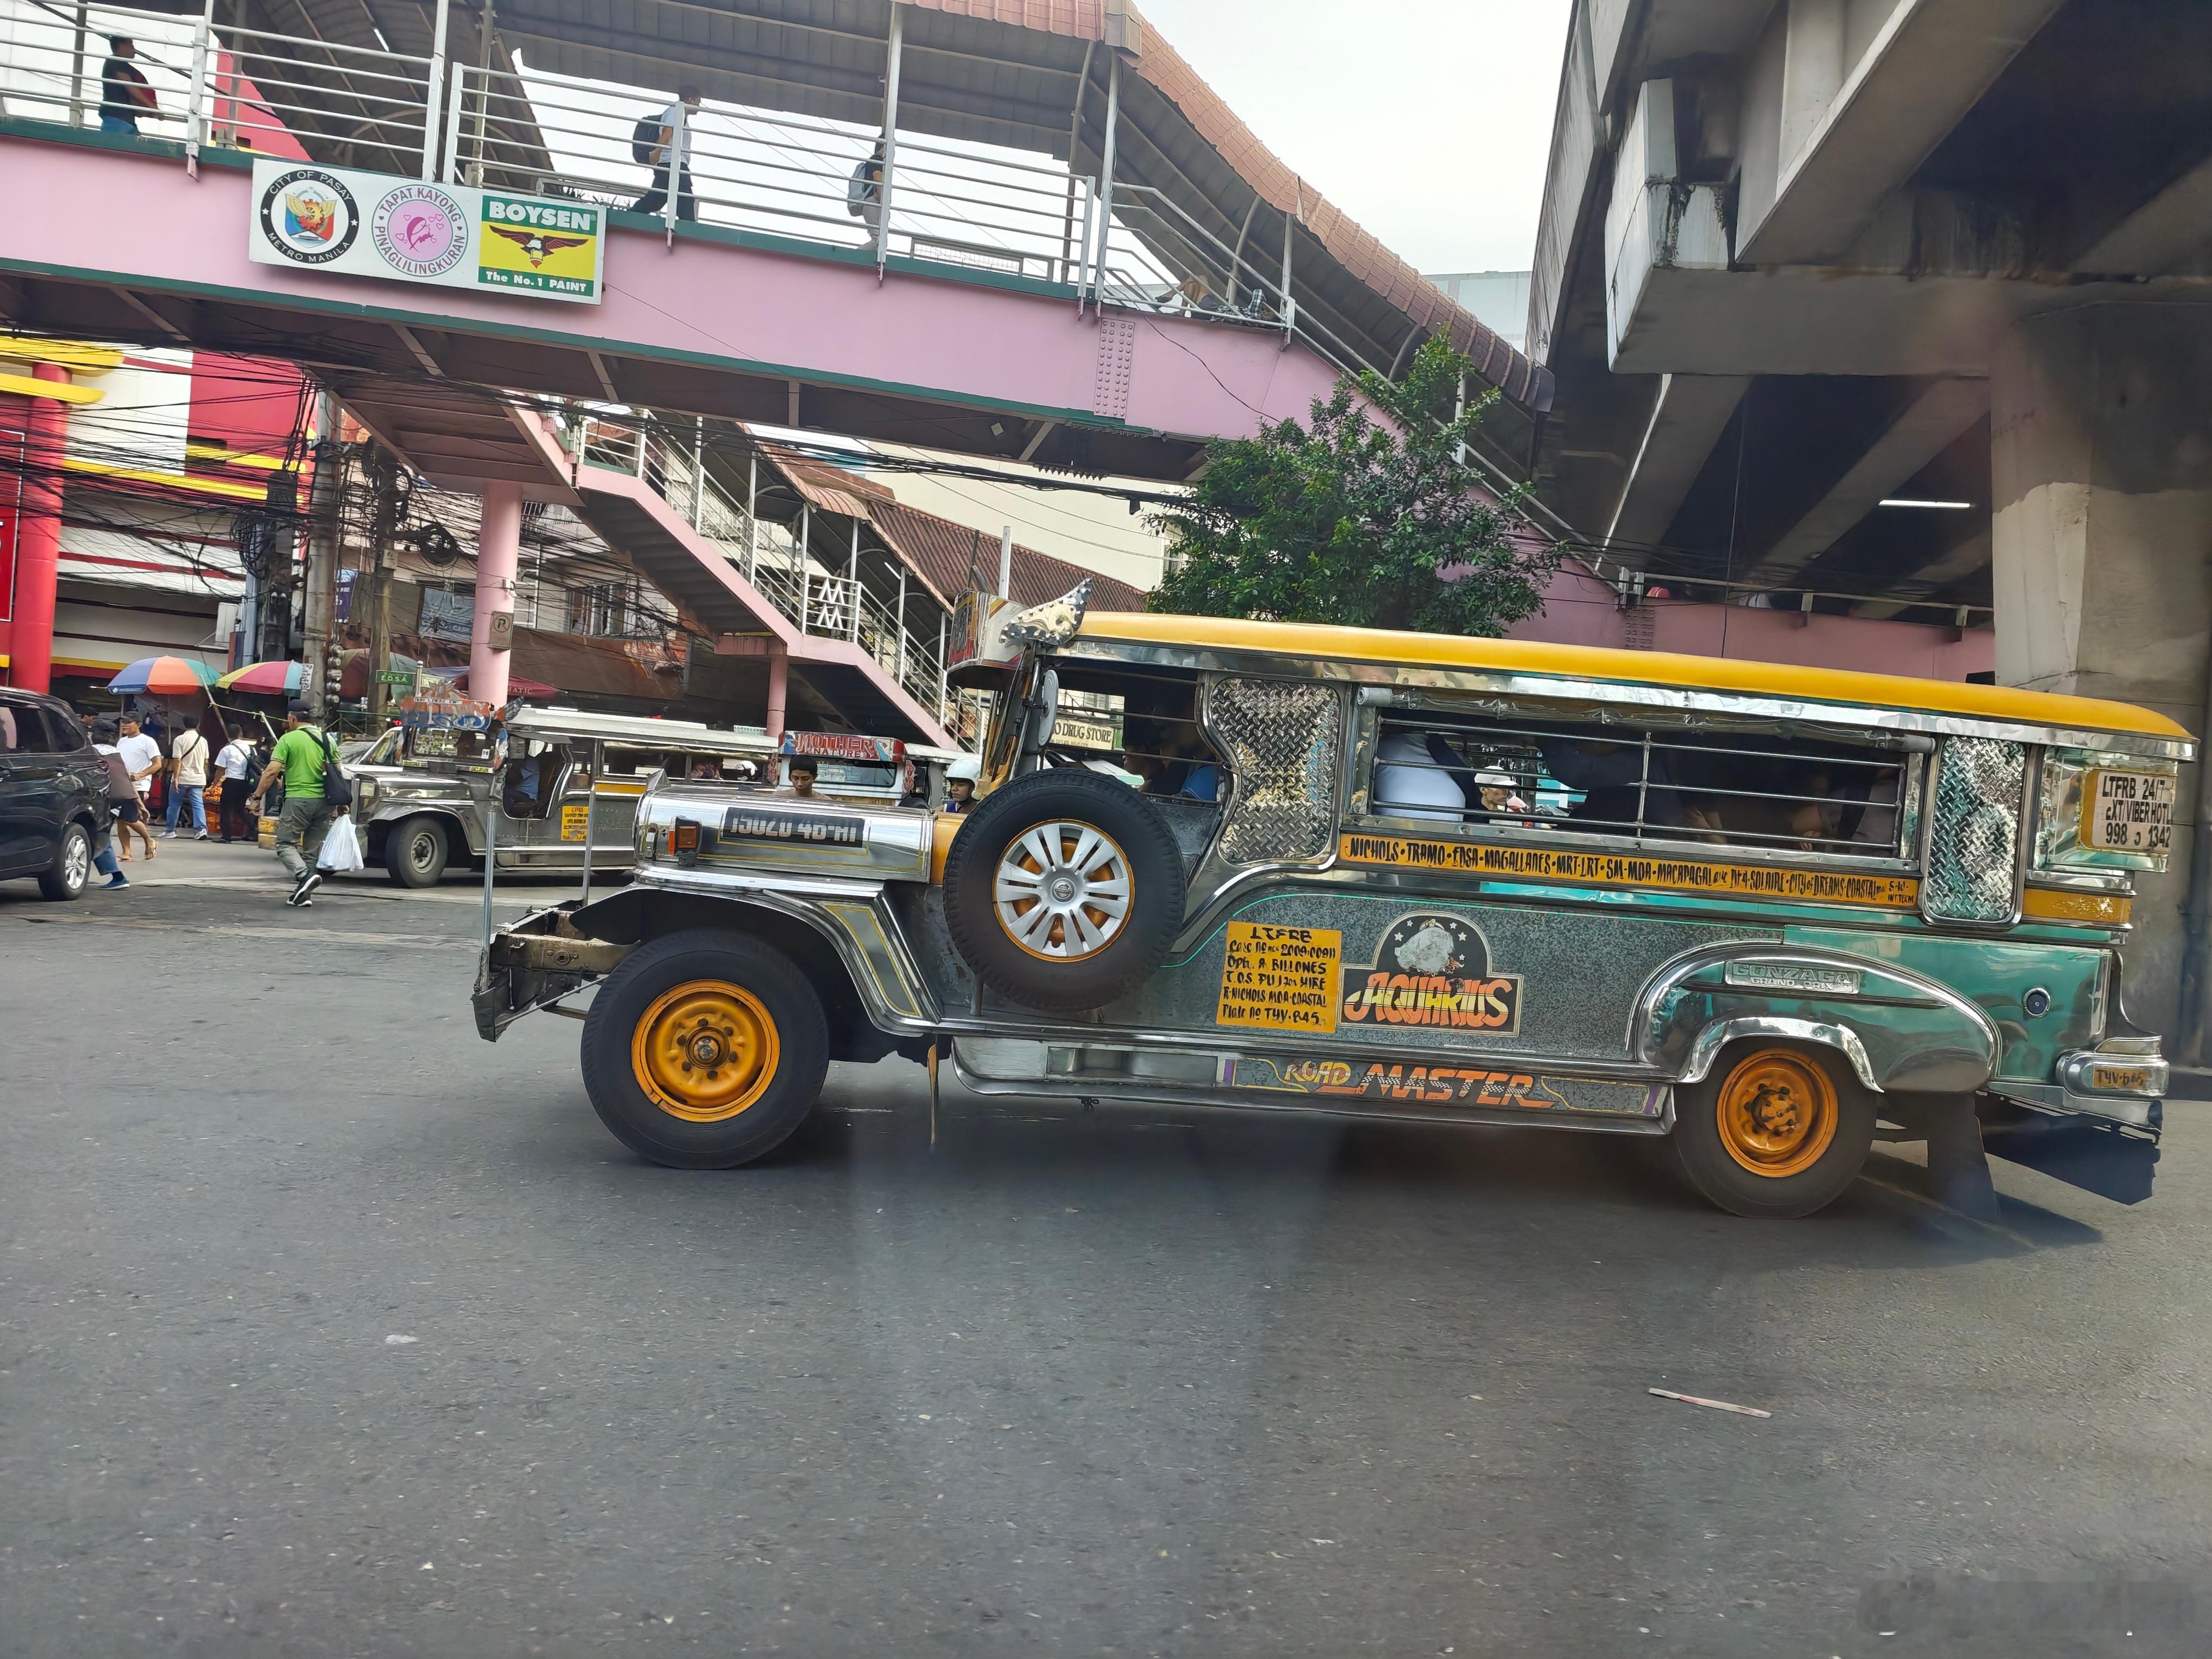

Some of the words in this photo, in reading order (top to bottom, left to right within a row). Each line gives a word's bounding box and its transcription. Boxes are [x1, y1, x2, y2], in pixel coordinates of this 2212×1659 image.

[270, 174, 291, 194] CITY
[297, 171, 315, 179] OF
[320, 174, 352, 200] PASAY
[380, 187, 413, 213] TAPAT
[417, 187, 461, 222] KAYONG
[489, 201, 590, 231] BOYSEN
[268, 232, 303, 260] METRO
[308, 241, 349, 263] MANILA
[375, 226, 465, 274] PINAGLILINGKURAN
[485, 271, 508, 282] The
[549, 279, 586, 292] PAINT
[1053, 722, 1062, 736] O
[1062, 723, 1085, 739] DRUG
[1086, 727, 1112, 743] STORE
[796, 733, 876, 758] MOTHER
[813, 748, 860, 758] NATURE
[2102, 775, 2136, 799] LTFRB
[2142, 778, 2166, 801] 24/7
[2148, 824, 2171, 848] 1342
[1345, 837, 1399, 862] NICHOLS
[1406, 842, 1445, 866] TRAMO
[1484, 849, 1550, 875] MAGALLANES
[1750, 868, 1785, 893] SOLAIRE
[1813, 874, 1844, 898] DREAMS
[1846, 877, 1877, 900] COASTAL
[1272, 958, 1327, 975] BILLONES
[1732, 963, 1853, 984] GONZAGA
[1257, 973, 1282, 988] PUJ
[1300, 976, 1326, 991] HIRE
[1750, 977, 1795, 987] GRAND
[1803, 981, 1834, 990] PRIX
[1344, 972, 1513, 1027] AQUARIUS
[1284, 1060, 1351, 1086] ROAD
[1357, 1063, 1555, 1108] MASTER
